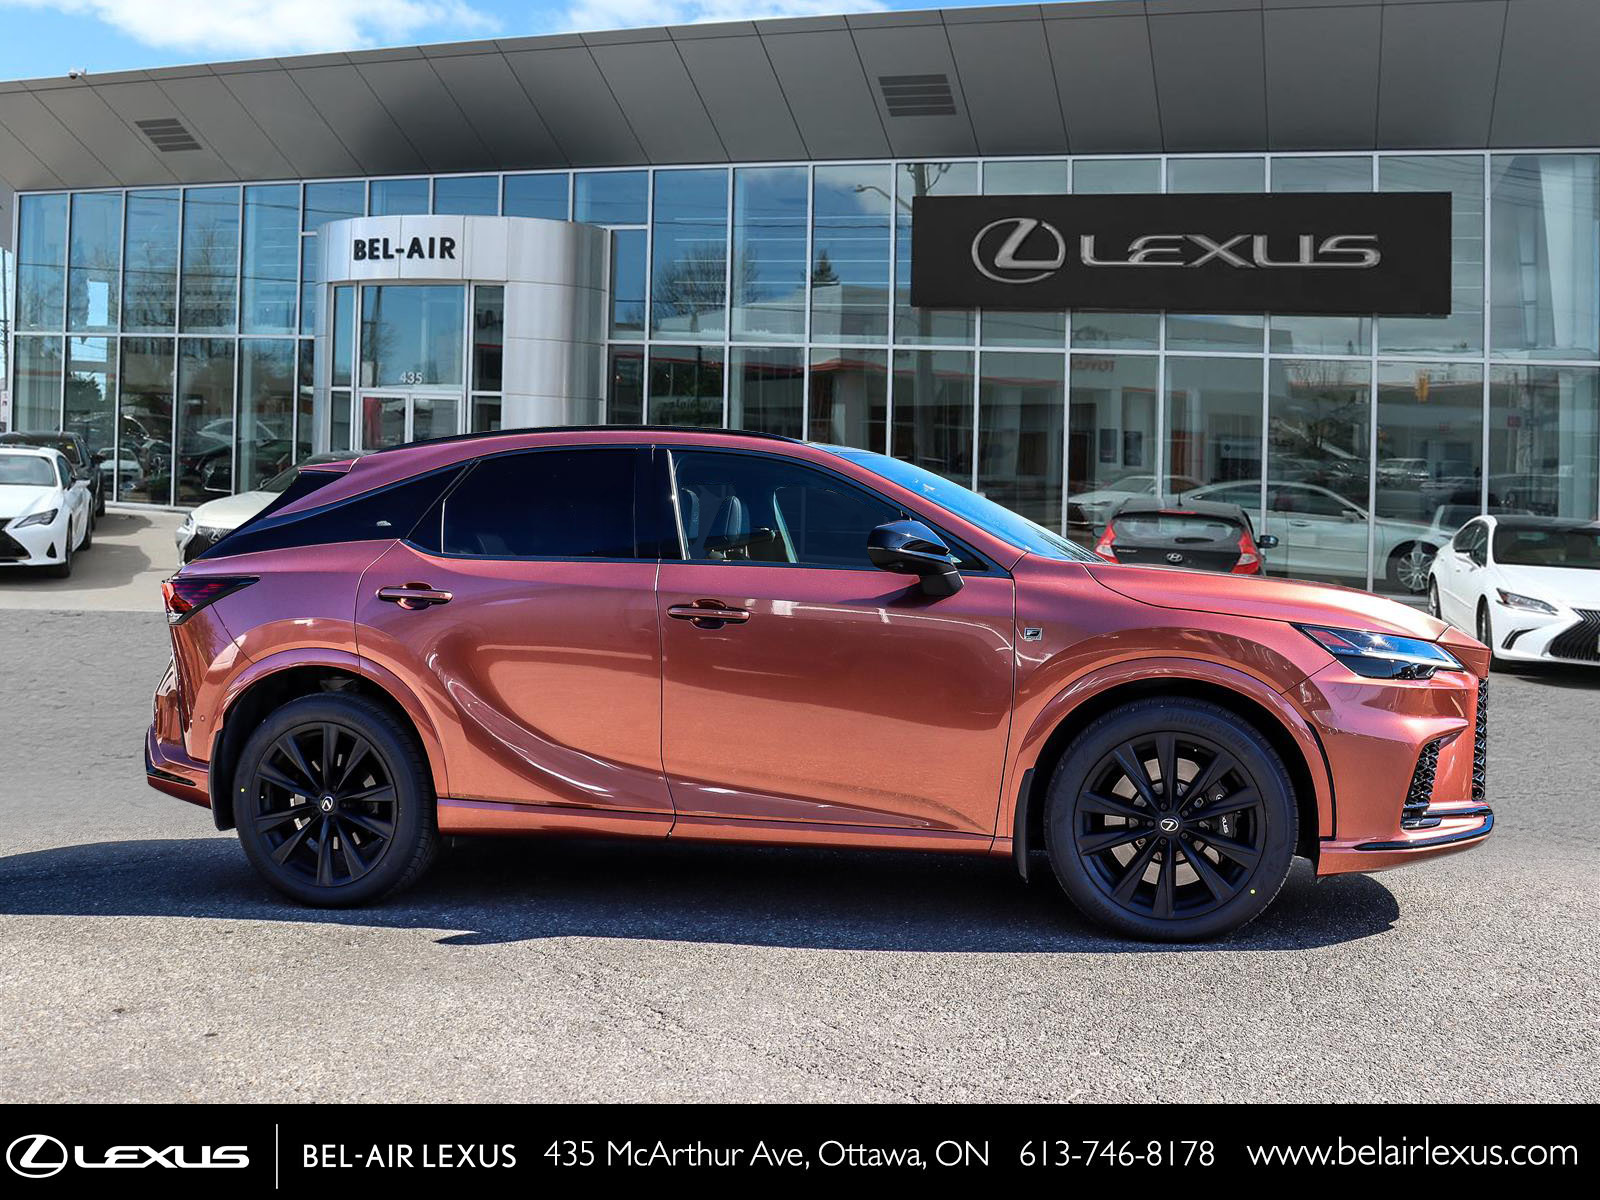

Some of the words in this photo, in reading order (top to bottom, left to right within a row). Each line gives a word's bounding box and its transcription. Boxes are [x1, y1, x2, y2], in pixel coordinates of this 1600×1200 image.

[353, 236, 456, 260] BEL-AIR
[1080, 233, 1382, 268] LEXUS
[400, 370, 424, 385] 435
